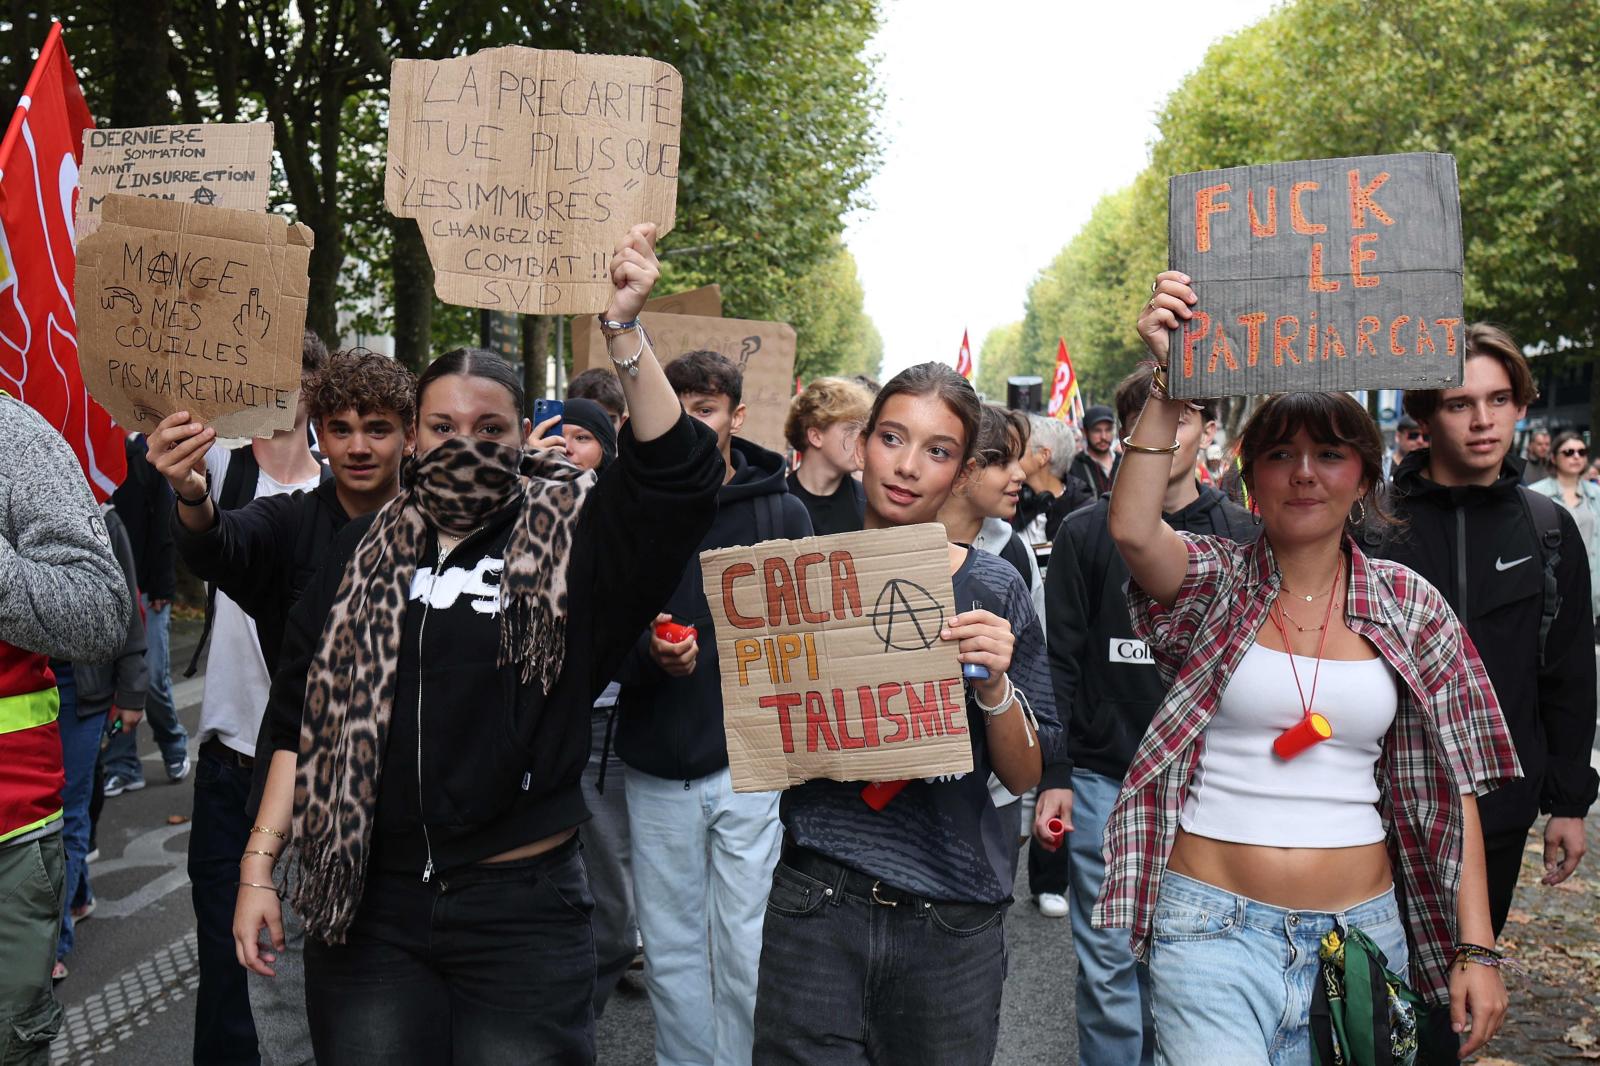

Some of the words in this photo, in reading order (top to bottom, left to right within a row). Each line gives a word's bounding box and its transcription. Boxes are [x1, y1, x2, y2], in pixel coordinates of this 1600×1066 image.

[424, 66, 479, 107] LA
[91, 163, 136, 175] AVANT
[411, 119, 504, 162] TUE
[530, 132, 615, 173] PLUS
[625, 137, 680, 179] QUE
[432, 220, 531, 244] CHANGEZ
[537, 229, 563, 245] DE
[1195, 168, 1396, 253] FUCK
[122, 243, 248, 294] MANGE
[465, 248, 581, 277] COMBAT
[1308, 232, 1380, 293] LE
[151, 298, 202, 331] MES
[475, 280, 561, 312] SVP
[115, 325, 248, 365] COUILLES
[108, 360, 141, 388] PAS
[145, 367, 171, 394] MA
[179, 371, 289, 409] RETRAITE
[722, 550, 863, 629] CACA
[734, 632, 820, 687] PIPI
[759, 677, 968, 754] TALISME
